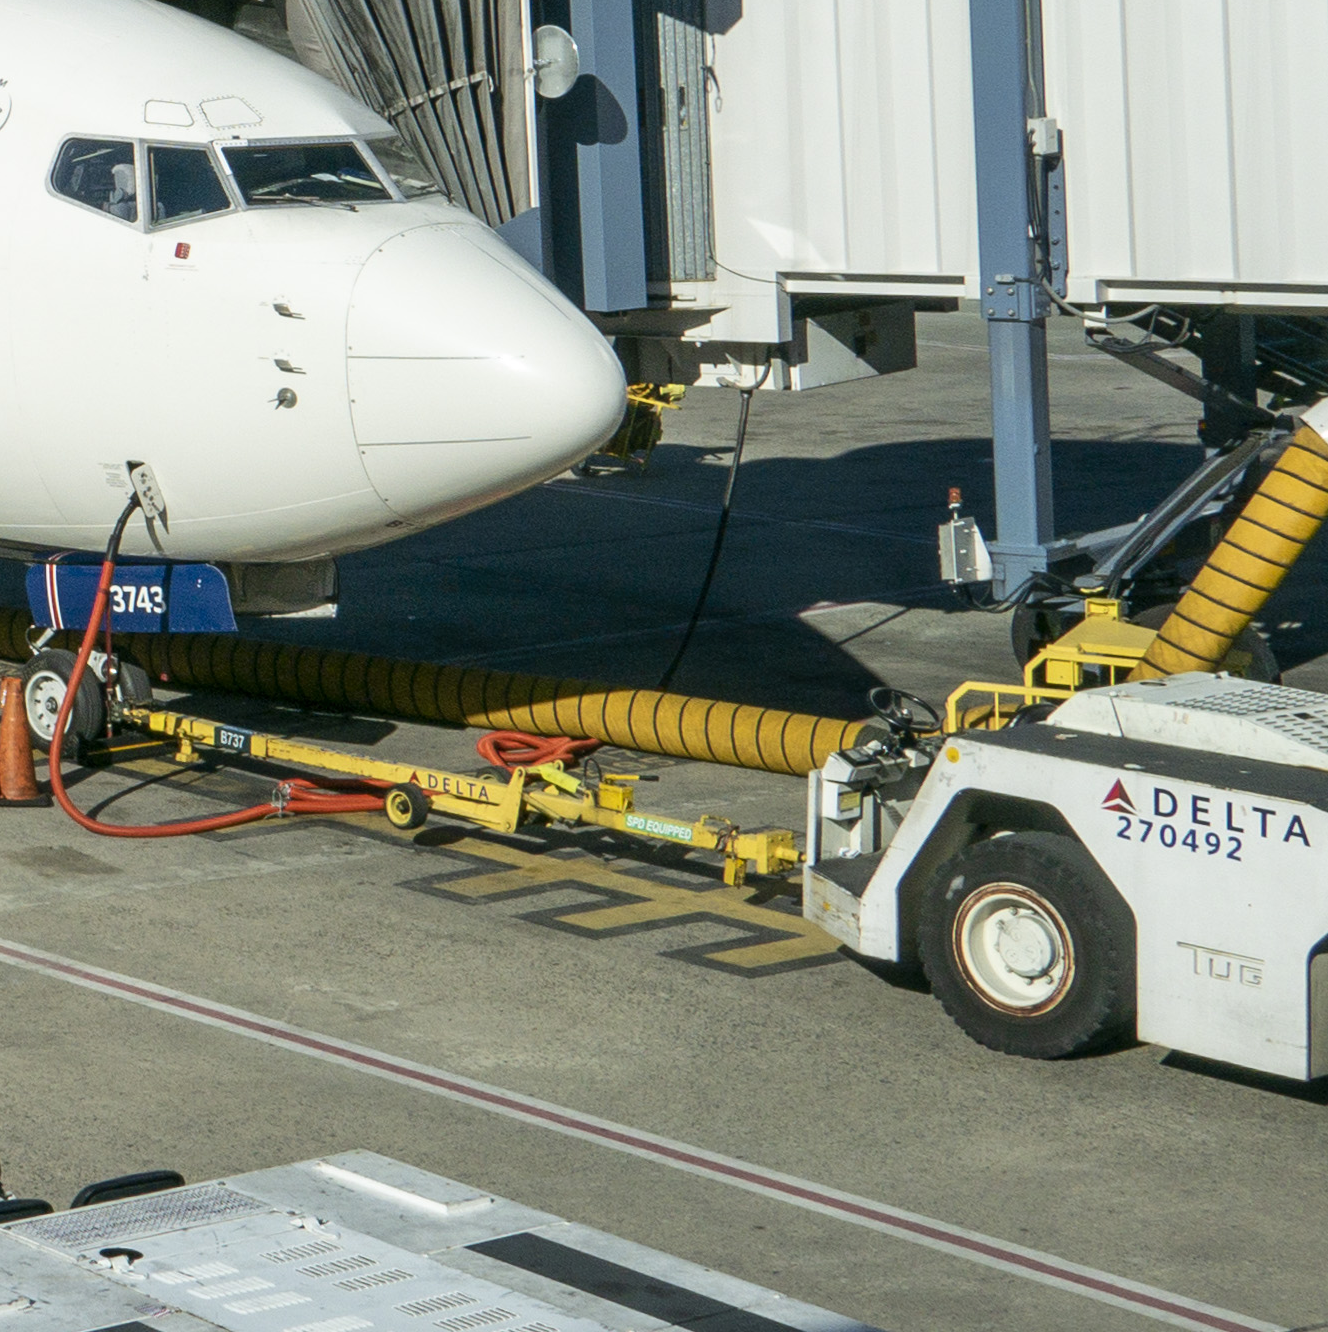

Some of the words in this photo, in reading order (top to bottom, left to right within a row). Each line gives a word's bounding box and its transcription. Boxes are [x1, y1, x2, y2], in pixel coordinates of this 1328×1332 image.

[109, 585, 167, 614] 3743
[220, 730, 245, 749] B737
[428, 773, 490, 801] DELTA
[625, 815, 645, 830] SPD
[645, 819, 692, 841] EQUIPPED
[1153, 787, 1311, 847] DELTA
[1116, 815, 1242, 862] 270492
[1176, 941, 1265, 989] TUG
